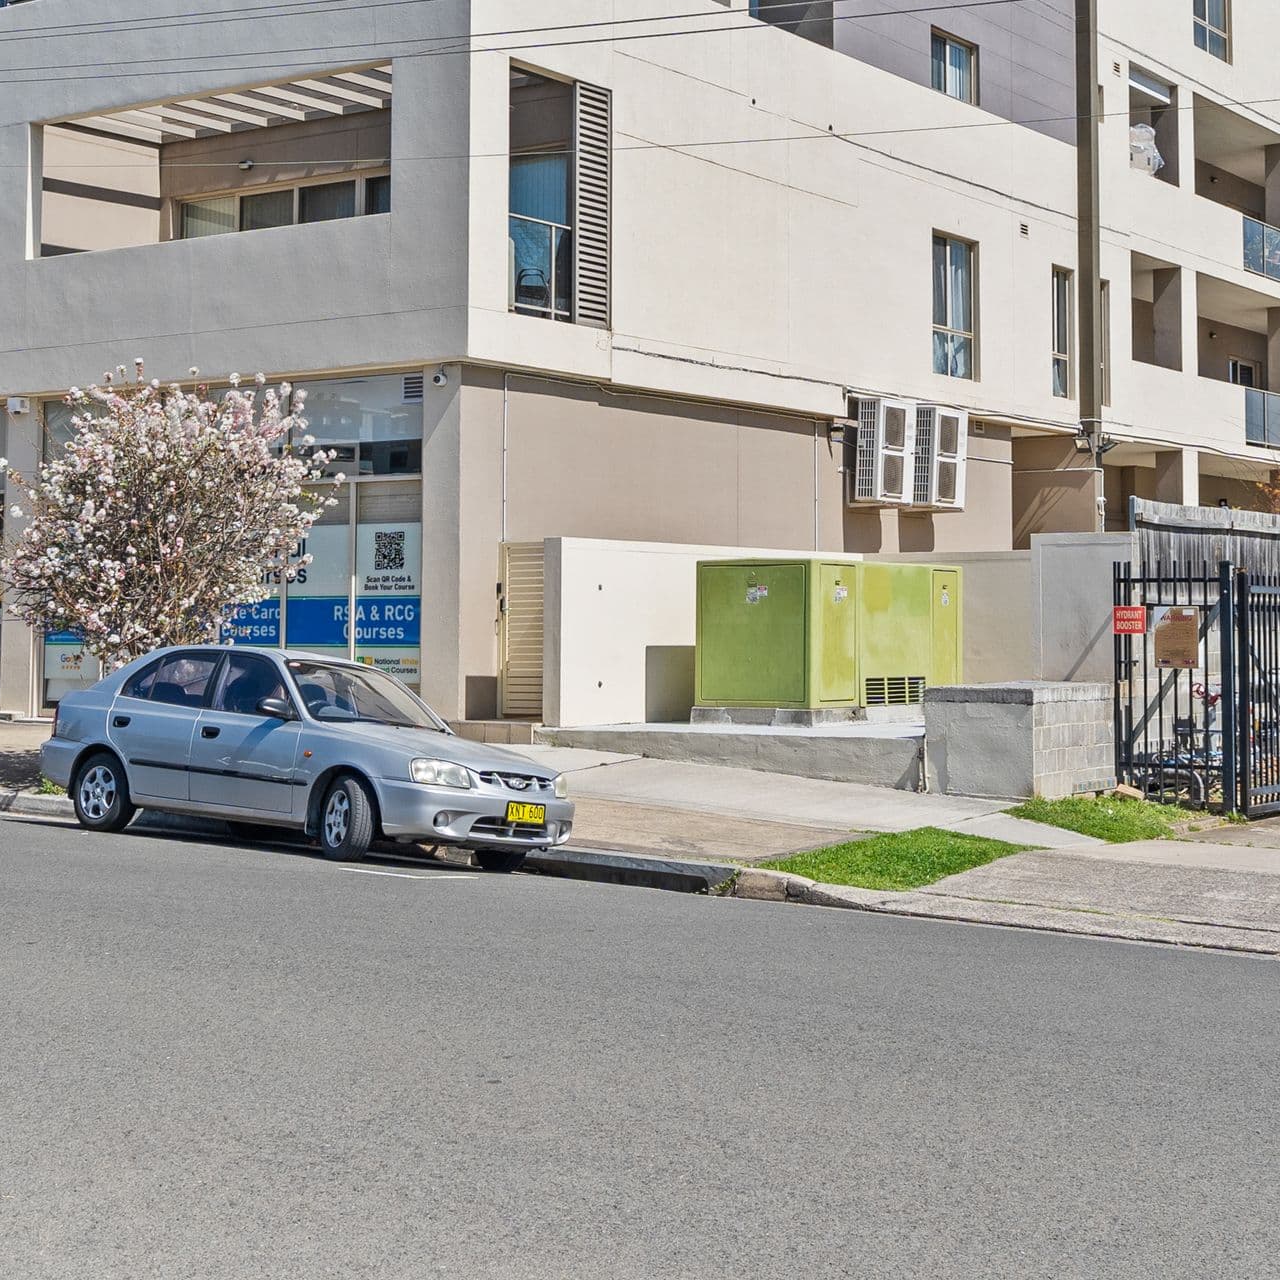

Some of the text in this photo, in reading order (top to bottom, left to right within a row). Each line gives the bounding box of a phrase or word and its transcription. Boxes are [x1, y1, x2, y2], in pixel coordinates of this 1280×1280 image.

[366, 575, 380, 583] Scan
[381, 575, 390, 583] QR
[391, 575, 406, 583] Code
[364, 583, 378, 591] Book
[380, 583, 393, 591] Your
[370, 605, 380, 621] &
[385, 605, 414, 621] RCG
[1116, 610, 1142, 620] HYDRANT
[1116, 620, 1142, 630] BOOSTER
[343, 625, 404, 639] Courses
